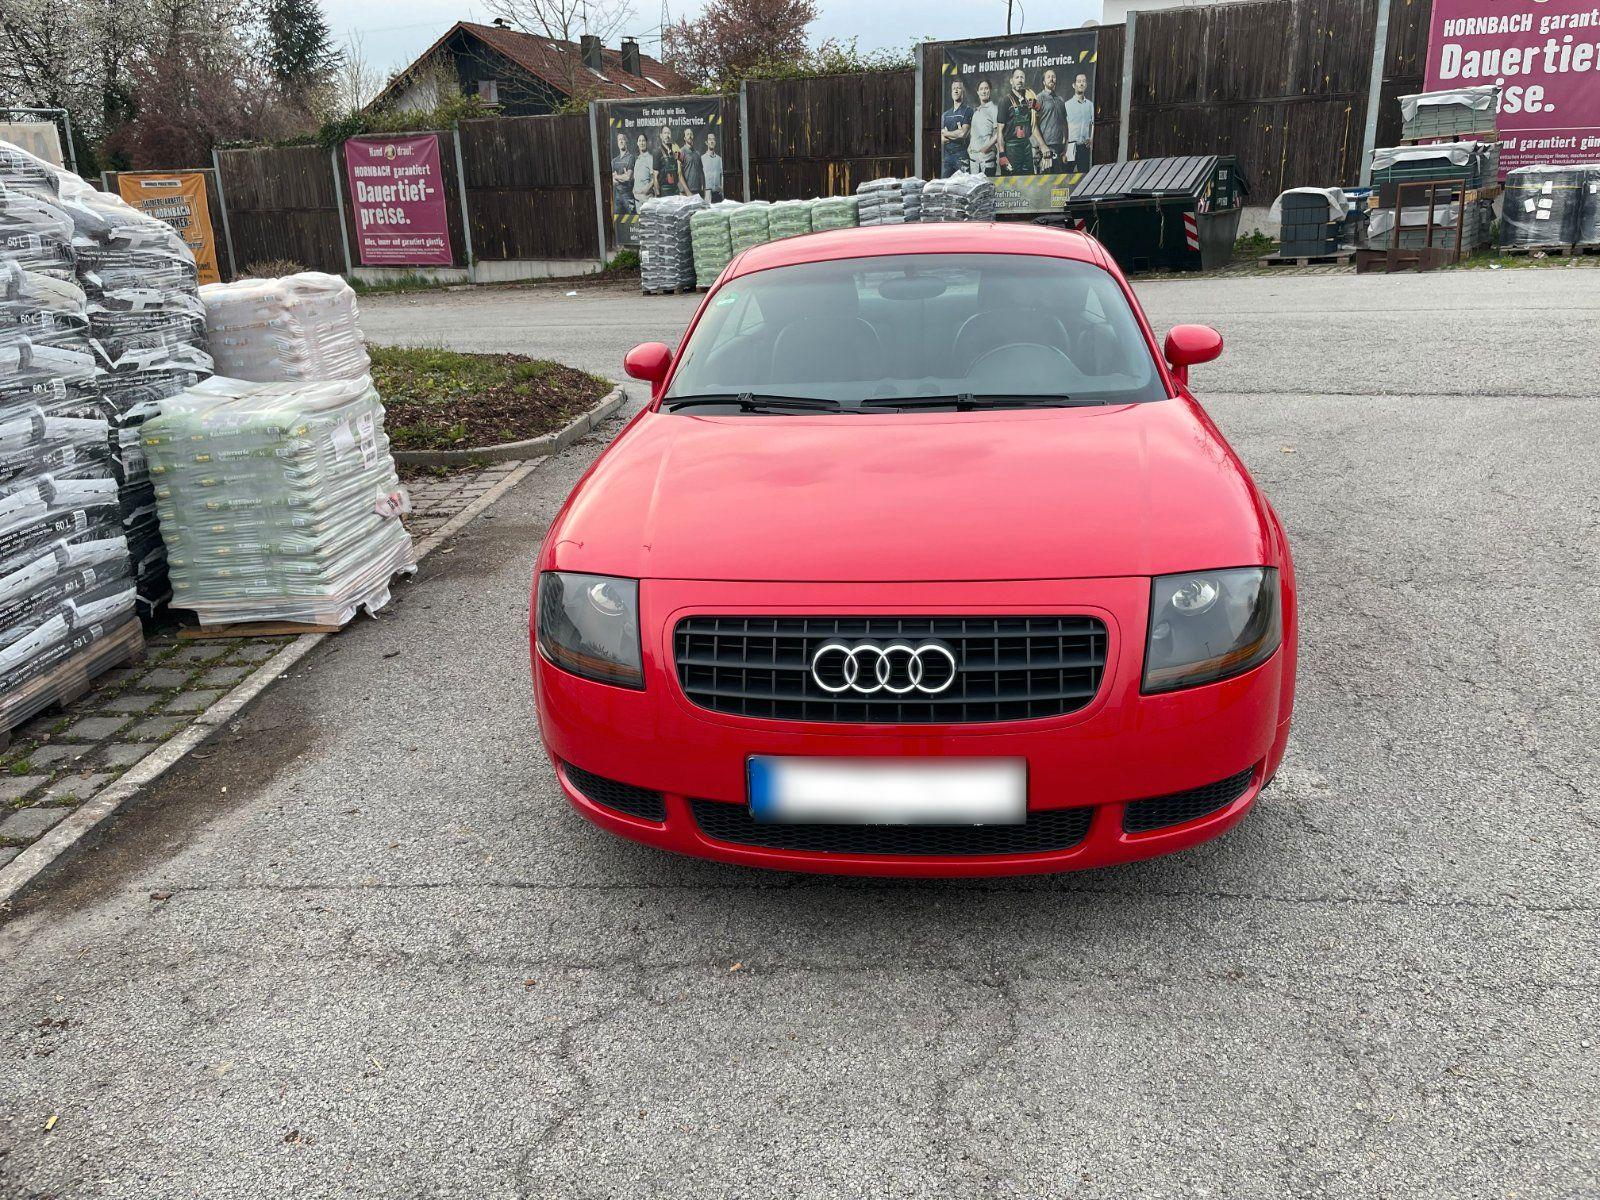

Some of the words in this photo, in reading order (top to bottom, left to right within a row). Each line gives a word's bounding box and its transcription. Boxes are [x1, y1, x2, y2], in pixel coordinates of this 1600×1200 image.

[1444, 13, 1533, 37] HORNBACH
[1538, 8, 1600, 34] garant
[987, 50, 998, 59] Für
[999, 48, 1018, 58] Profis
[1020, 48, 1032, 56] wie
[1034, 44, 1048, 55] Dich.
[1440, 35, 1600, 80] Dauertie
[962, 63, 976, 74] Der
[979, 59, 1020, 73] HORNBACH
[1022, 54, 1074, 68] ProfiService.
[1496, 78, 1555, 114] ise.
[625, 119, 634, 128] Der
[637, 118, 667, 127] HORNBACH
[668, 116, 706, 126] ProfiService.
[1500, 137, 1516, 149] nd
[1520, 136, 1576, 151] garantiert
[1580, 136, 1600, 150] gün
[354, 166, 391, 178] HORNBACH
[393, 164, 430, 178] garantiert
[356, 179, 434, 203] Dauertief-
[155, 205, 191, 218] HORNBACH
[360, 202, 410, 230] preise.
[164, 217, 191, 229] ERKER-
[7, 236, 17, 247] 60
[21, 315, 28, 324] 60
[32, 384, 42, 394] 60
[55, 521, 65, 532] 60
[66, 519, 71, 528] L
[65, 583, 74, 591] 60
[75, 579, 80, 587] L
[73, 638, 82, 648] 60
[82, 635, 88, 644] L
